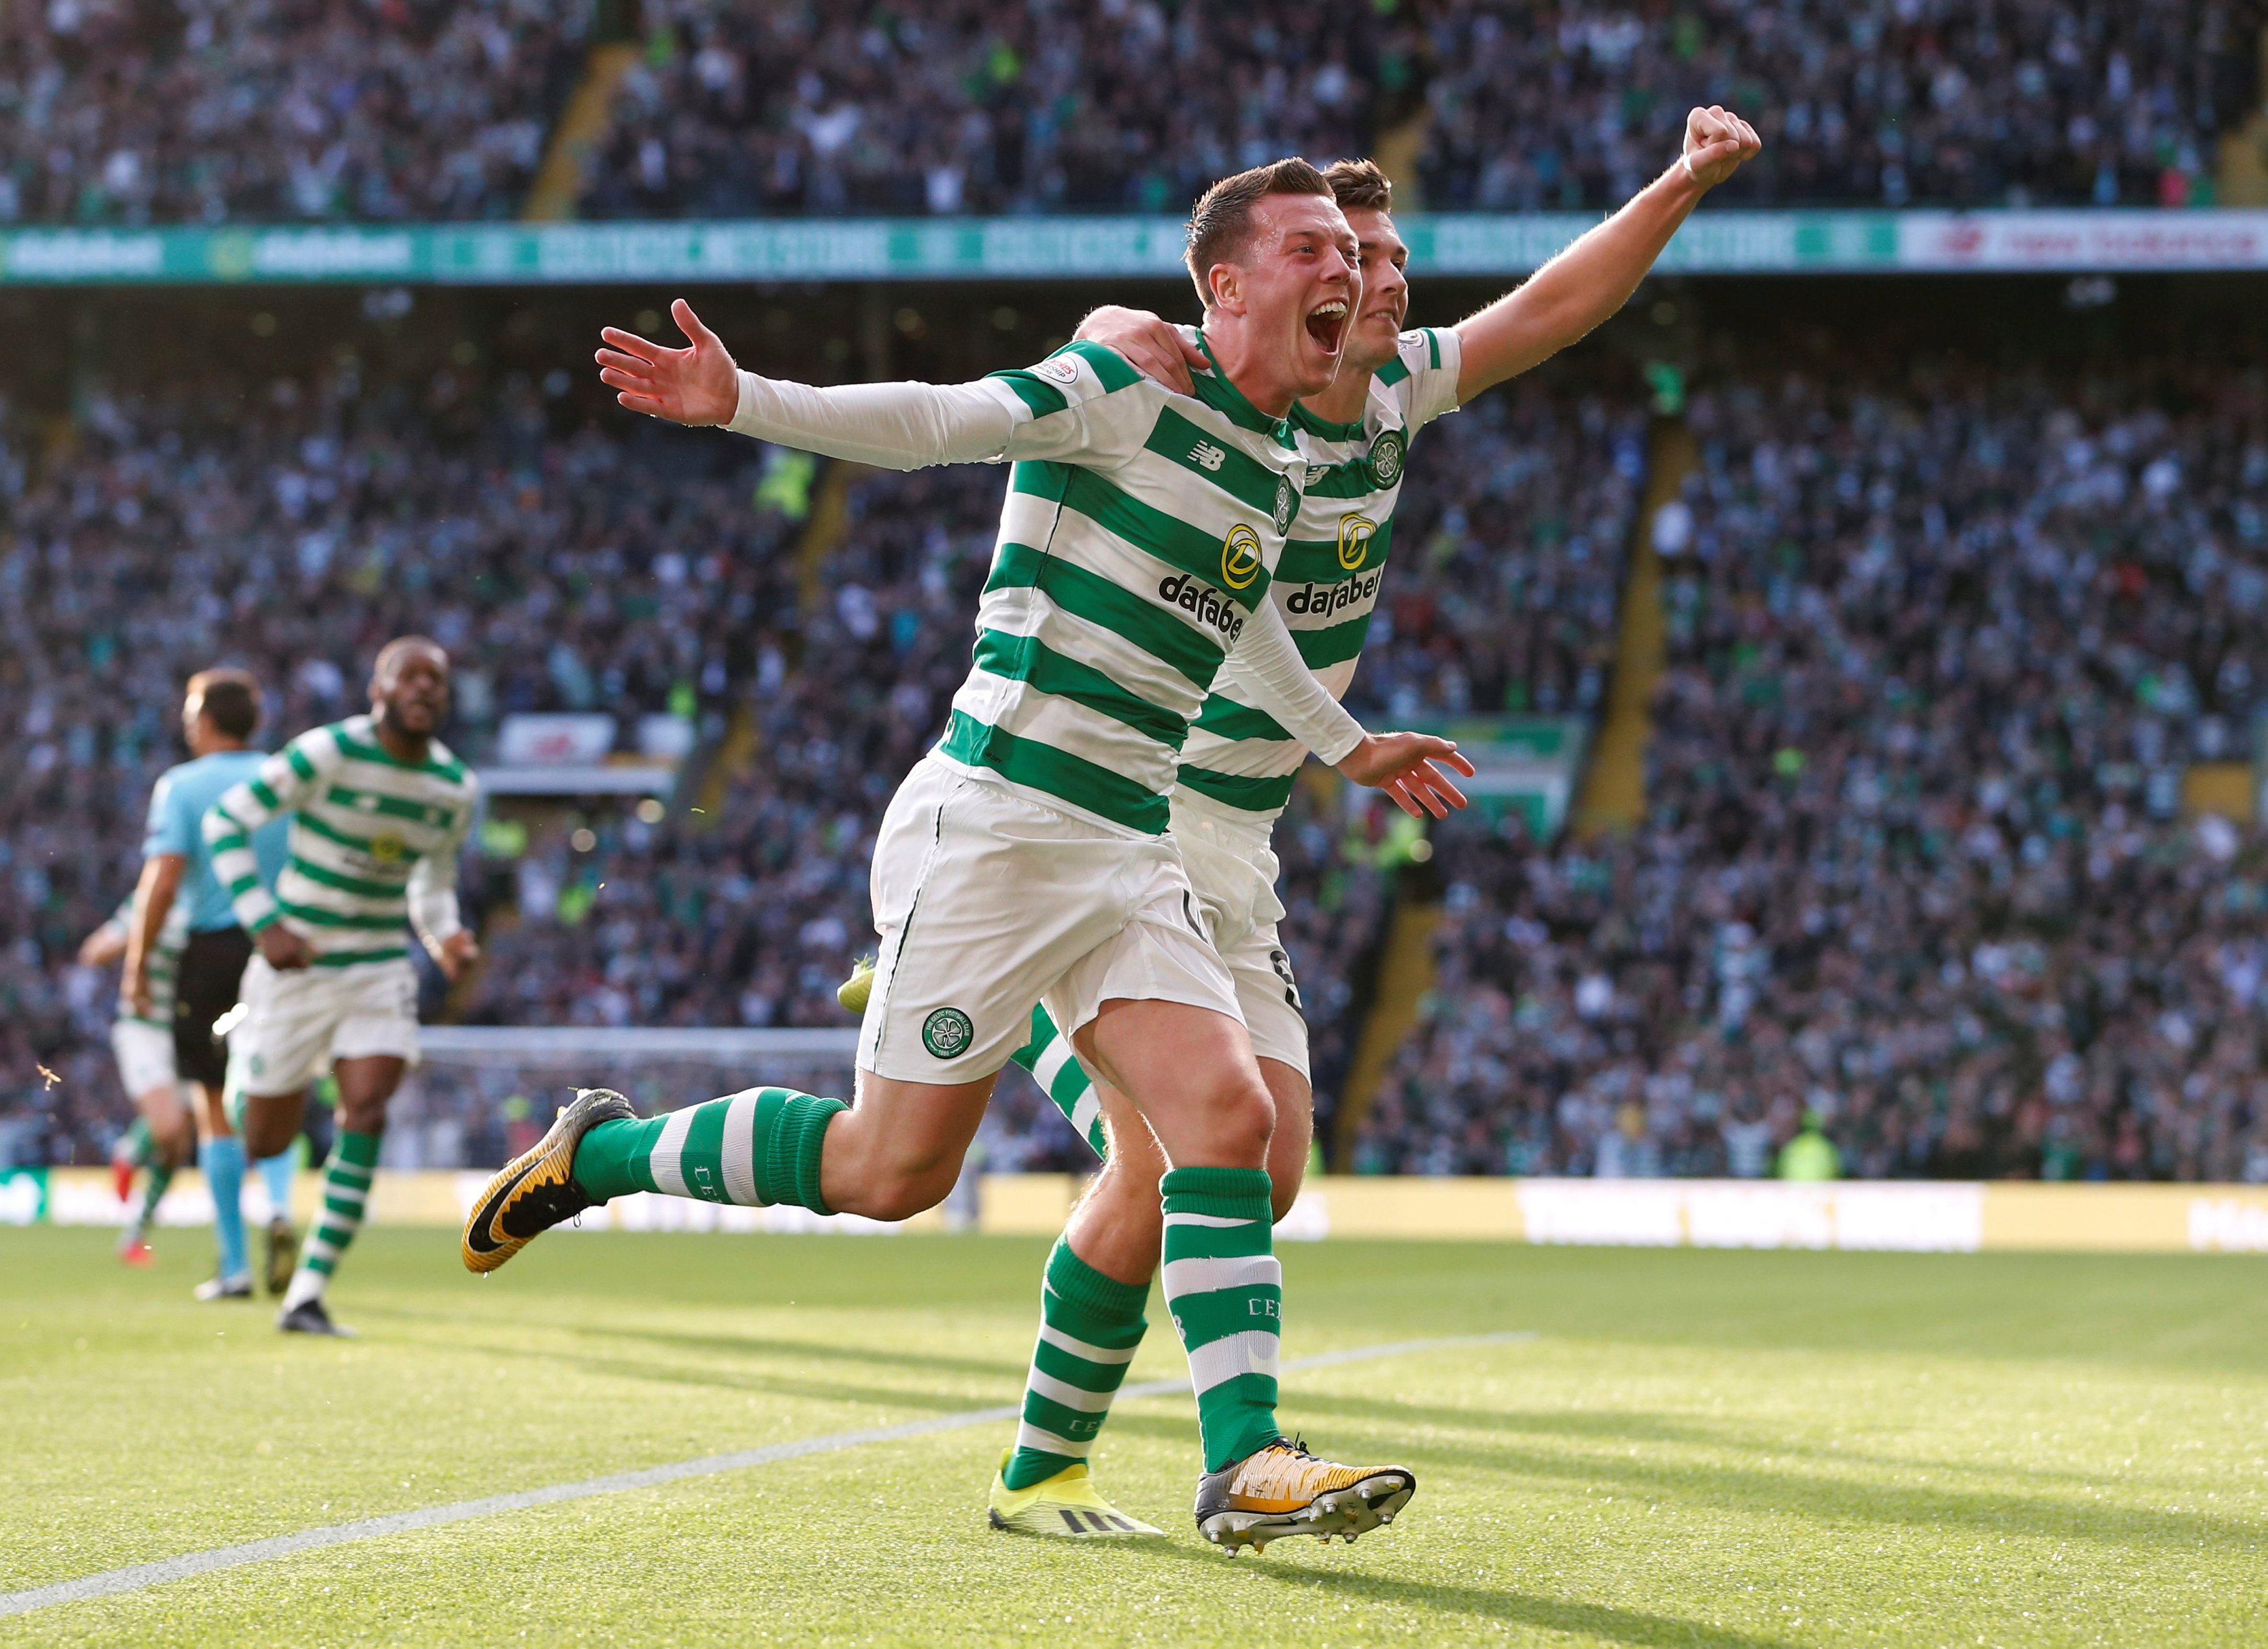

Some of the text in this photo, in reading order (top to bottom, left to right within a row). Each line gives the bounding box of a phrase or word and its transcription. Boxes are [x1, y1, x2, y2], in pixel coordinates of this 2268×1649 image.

[1159, 574, 1244, 644] dafabe
[931, 1011, 945, 1022] CELTIC
[945, 1010, 966, 1024] FOOTBALL
